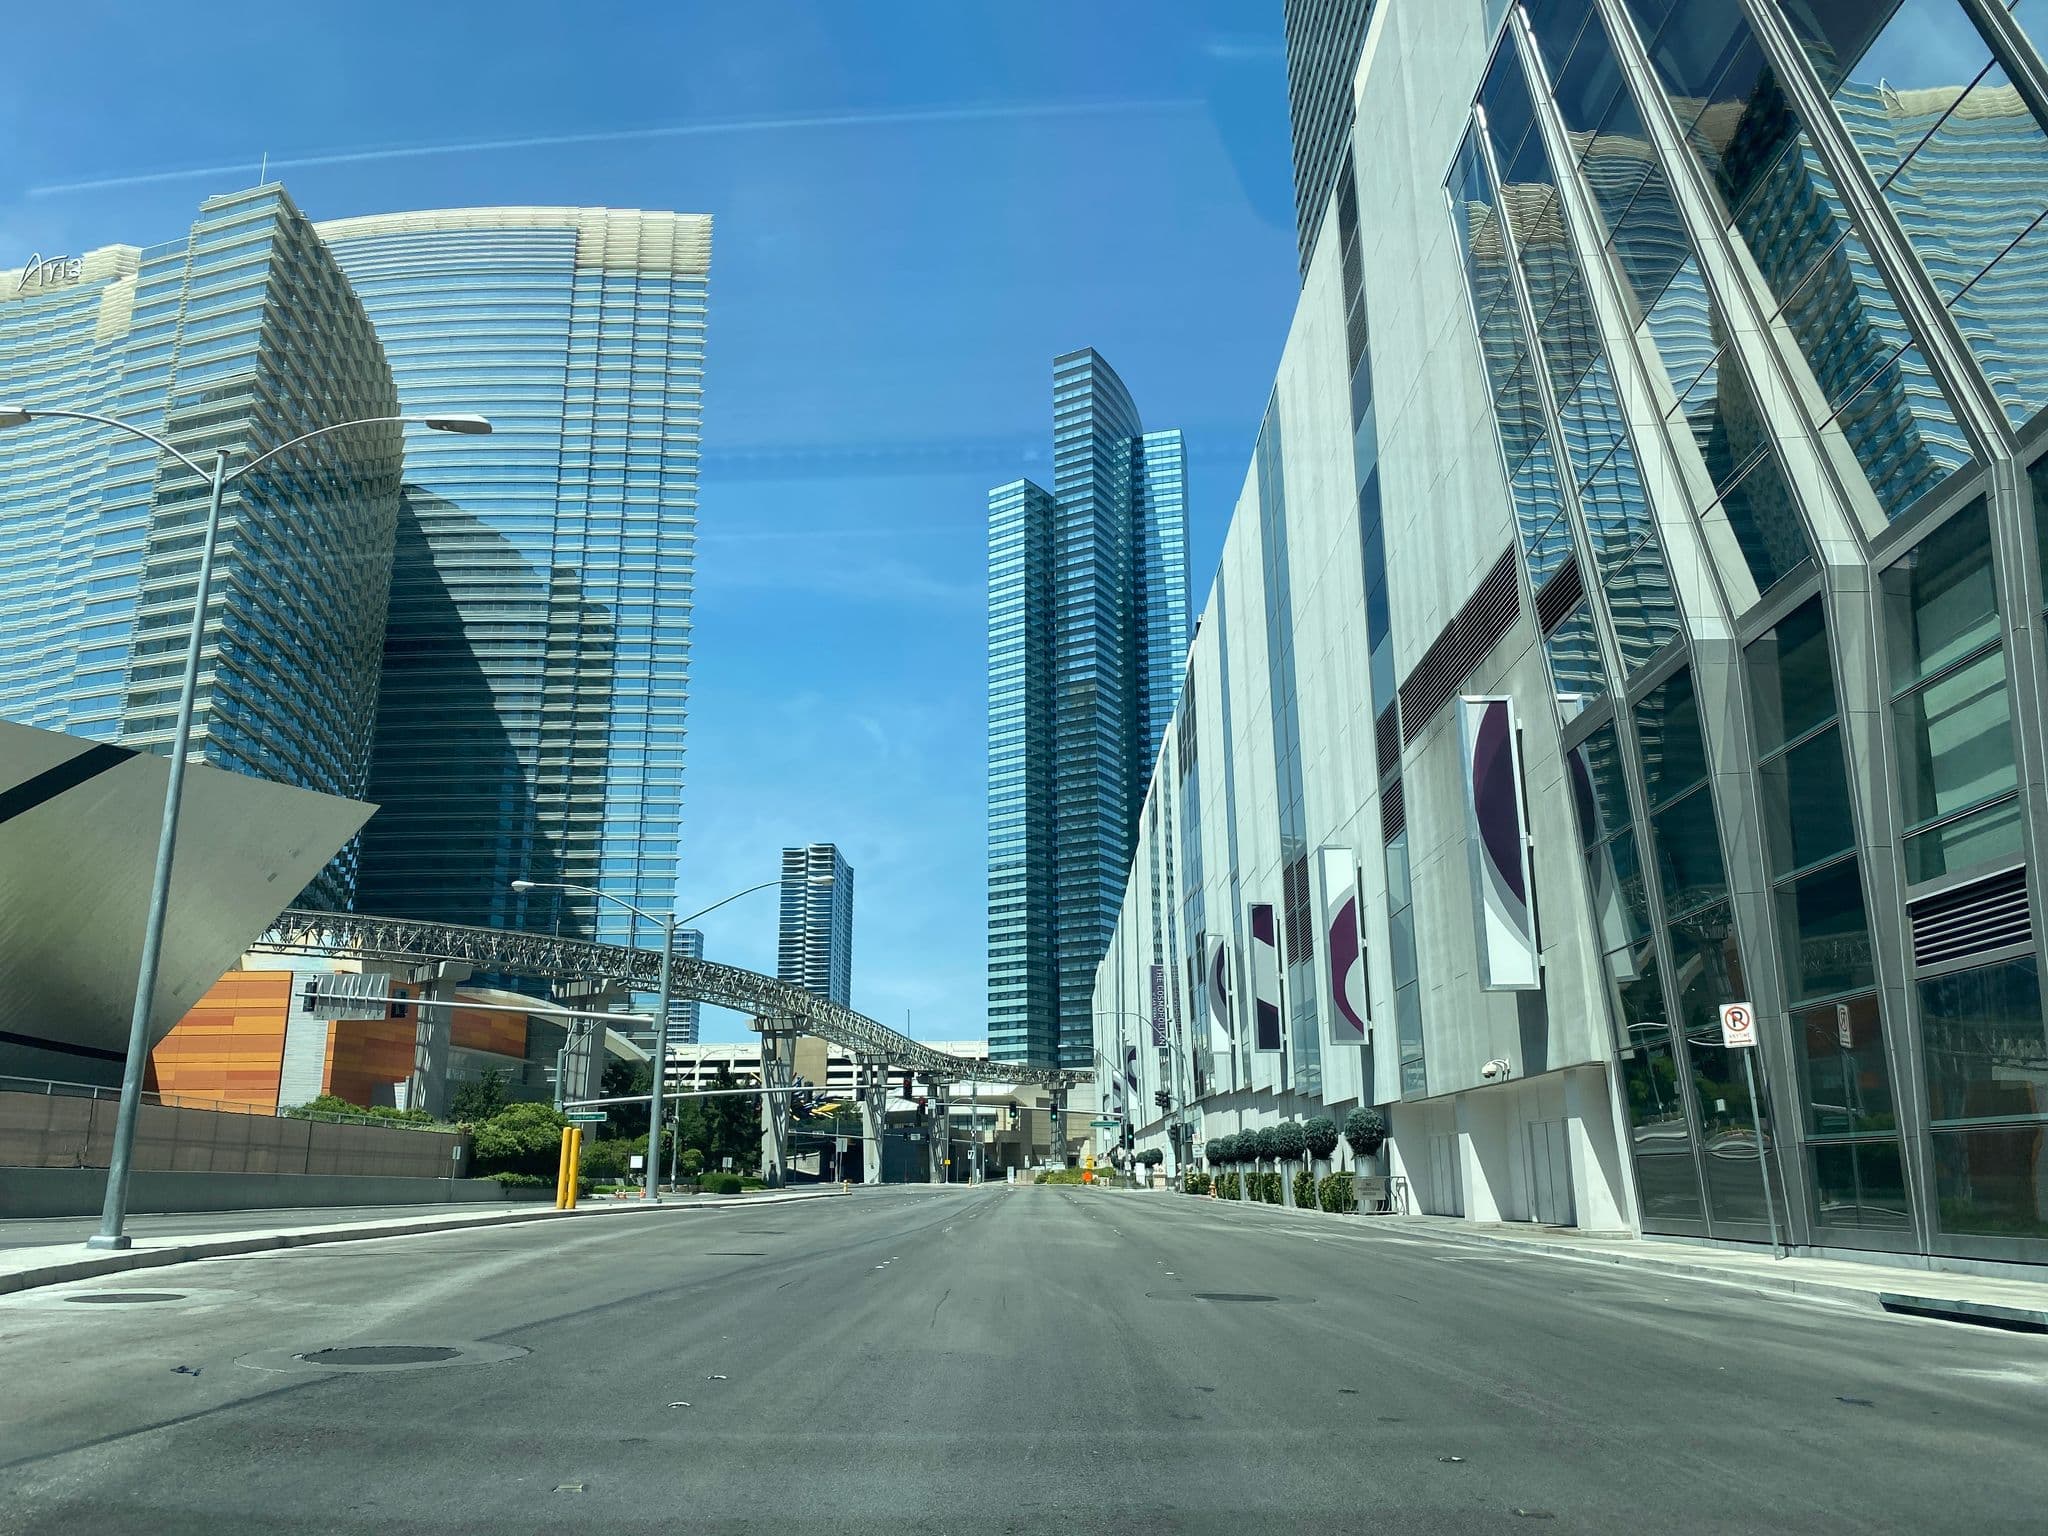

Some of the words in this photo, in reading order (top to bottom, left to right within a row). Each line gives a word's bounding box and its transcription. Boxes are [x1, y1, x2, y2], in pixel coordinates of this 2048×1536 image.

[17, 252, 82, 291] Aria
[1156, 967, 1164, 983] THE
[1157, 985, 1166, 1045] COSMOPOLITAN
